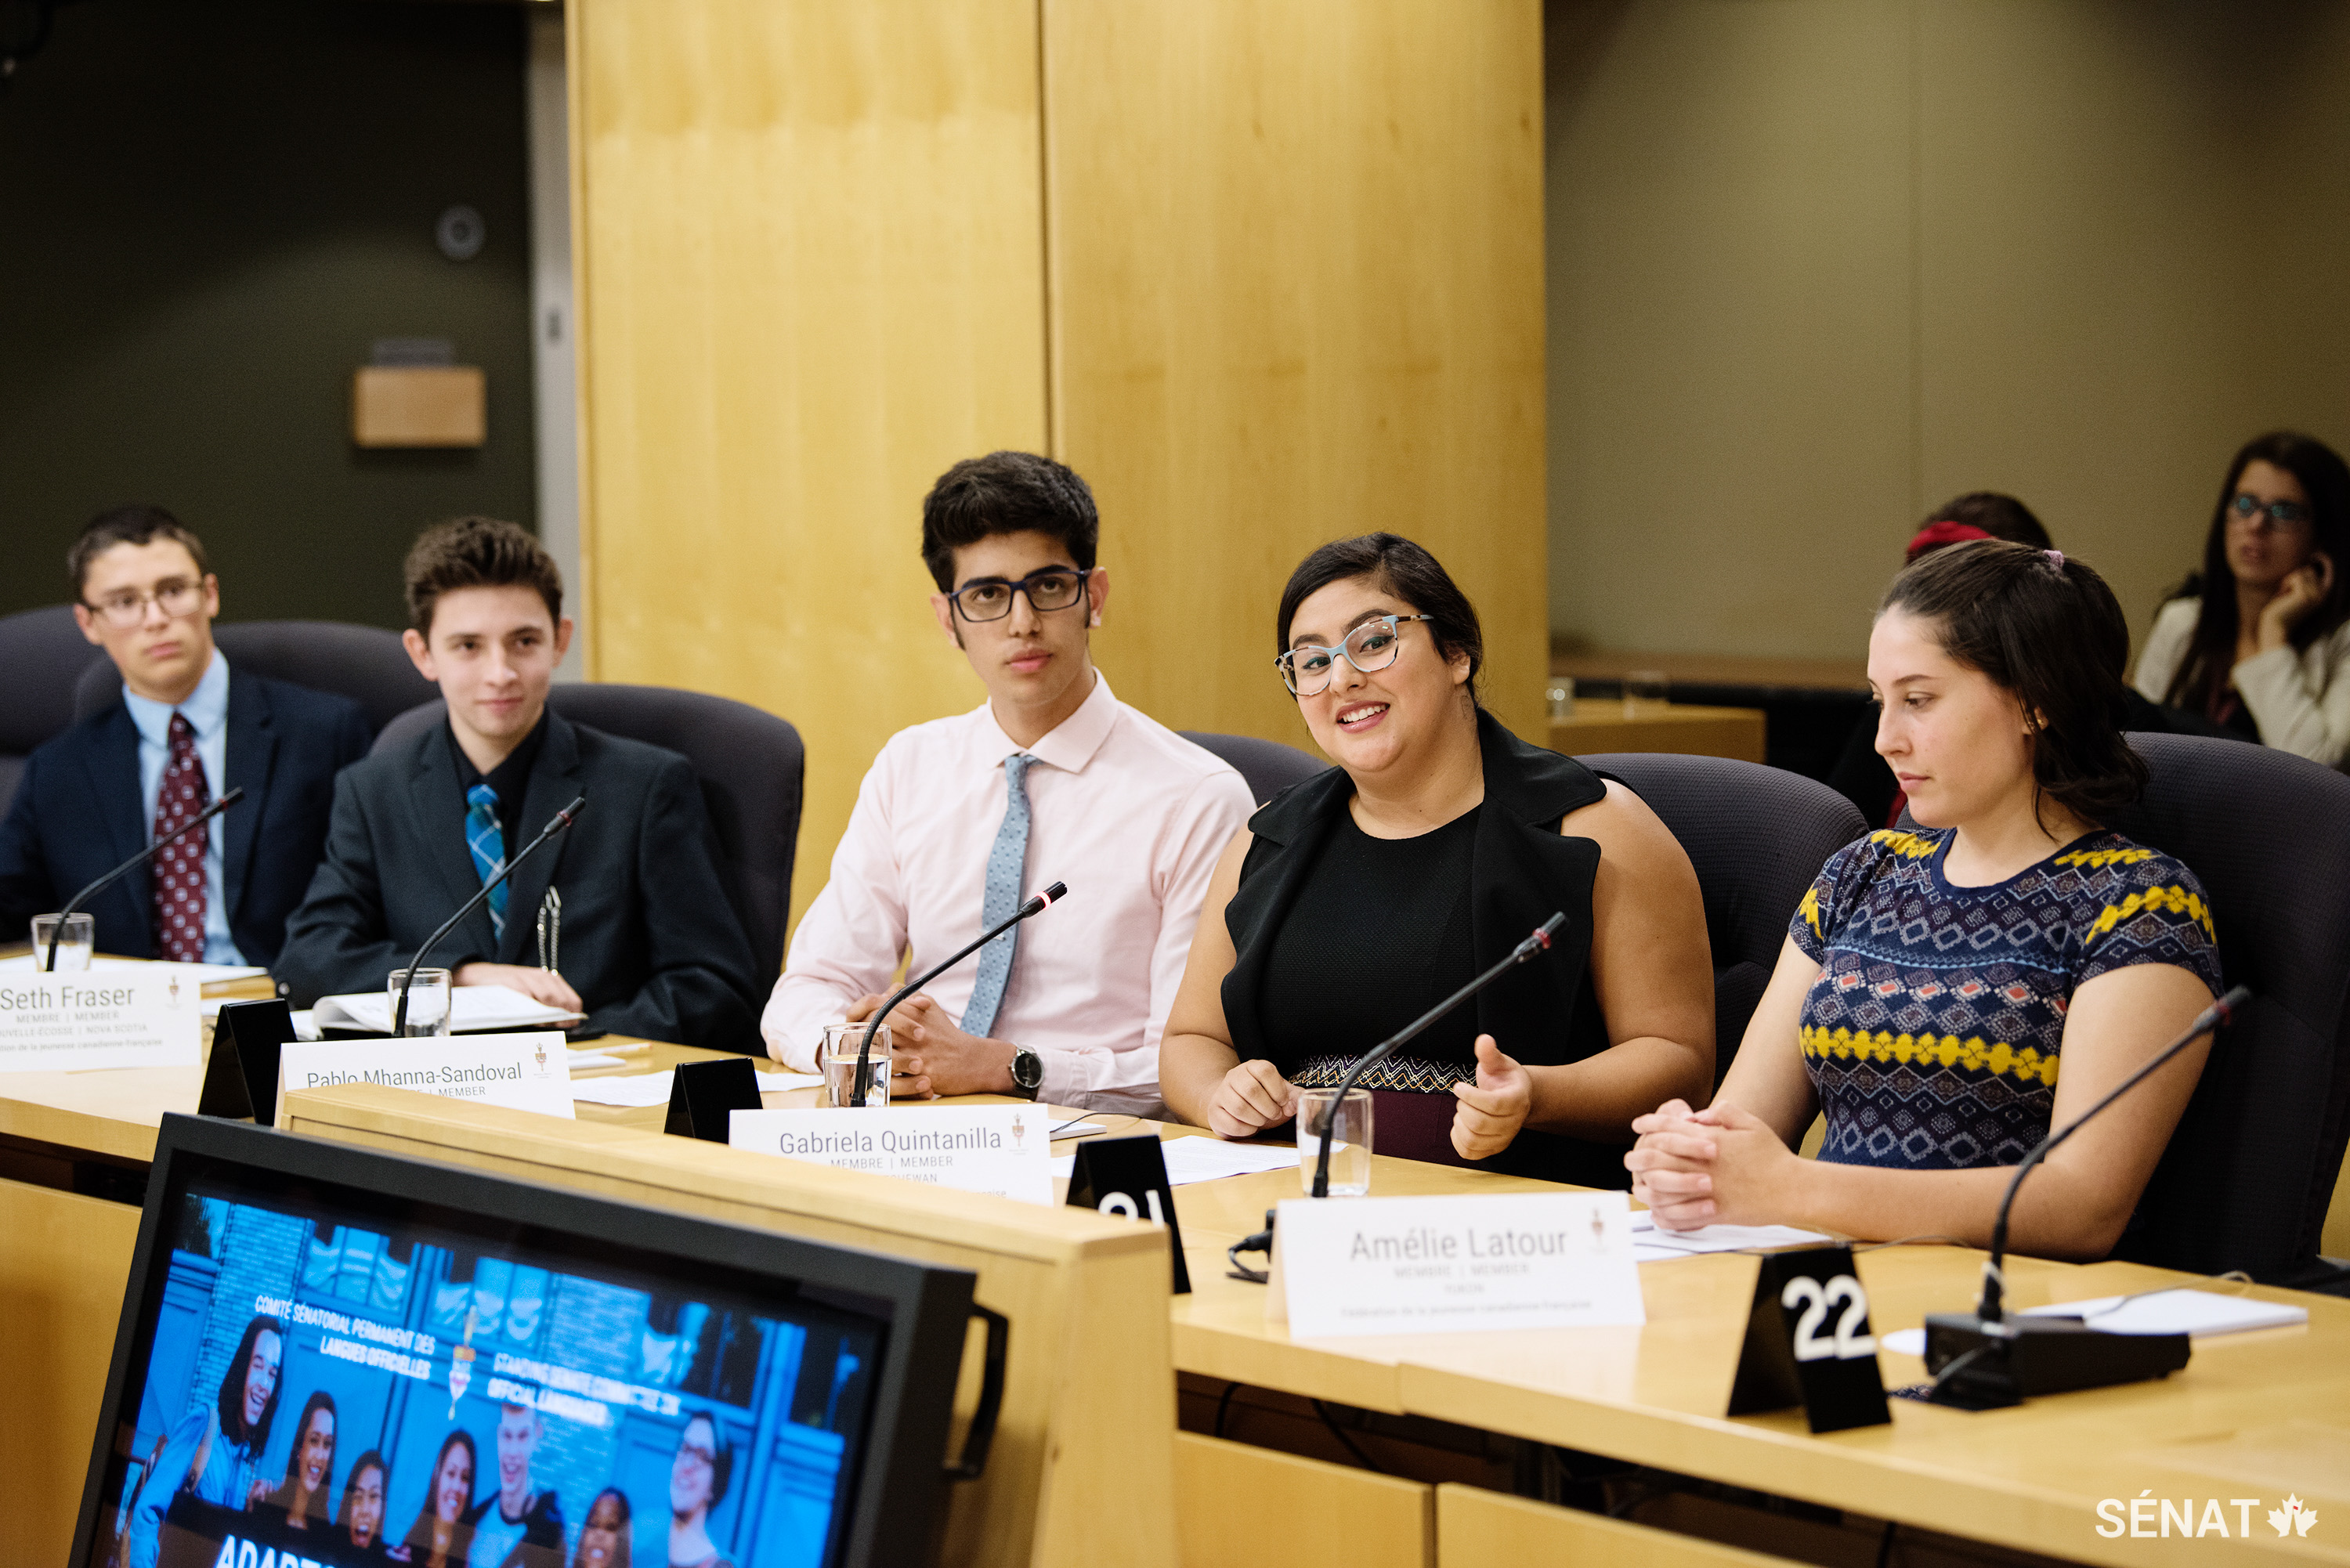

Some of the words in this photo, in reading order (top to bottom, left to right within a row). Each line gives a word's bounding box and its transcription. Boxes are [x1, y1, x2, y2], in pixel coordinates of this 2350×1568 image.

[1, 987, 52, 1010] Seth
[61, 985, 135, 1008] Fraser
[16, 1013, 60, 1024] MEMBRE
[75, 1010, 120, 1022] MEMBER
[307, 1071, 358, 1088] Pablo
[364, 1060, 522, 1086] Mhanna-Sandoval
[439, 1086, 486, 1097] MEMBER
[779, 1130, 873, 1154] Gabriela
[881, 1127, 1002, 1154] Quintanilla
[830, 1157, 884, 1170] MEMBRE
[900, 1155, 954, 1168] MEMBER
[1350, 1227, 1457, 1260] Amélie
[1469, 1228, 1567, 1258] Latour
[255, 1295, 293, 1320] COMITÉ
[293, 1301, 351, 1335] SÉNATORIAL
[1781, 1274, 1877, 1362] 22
